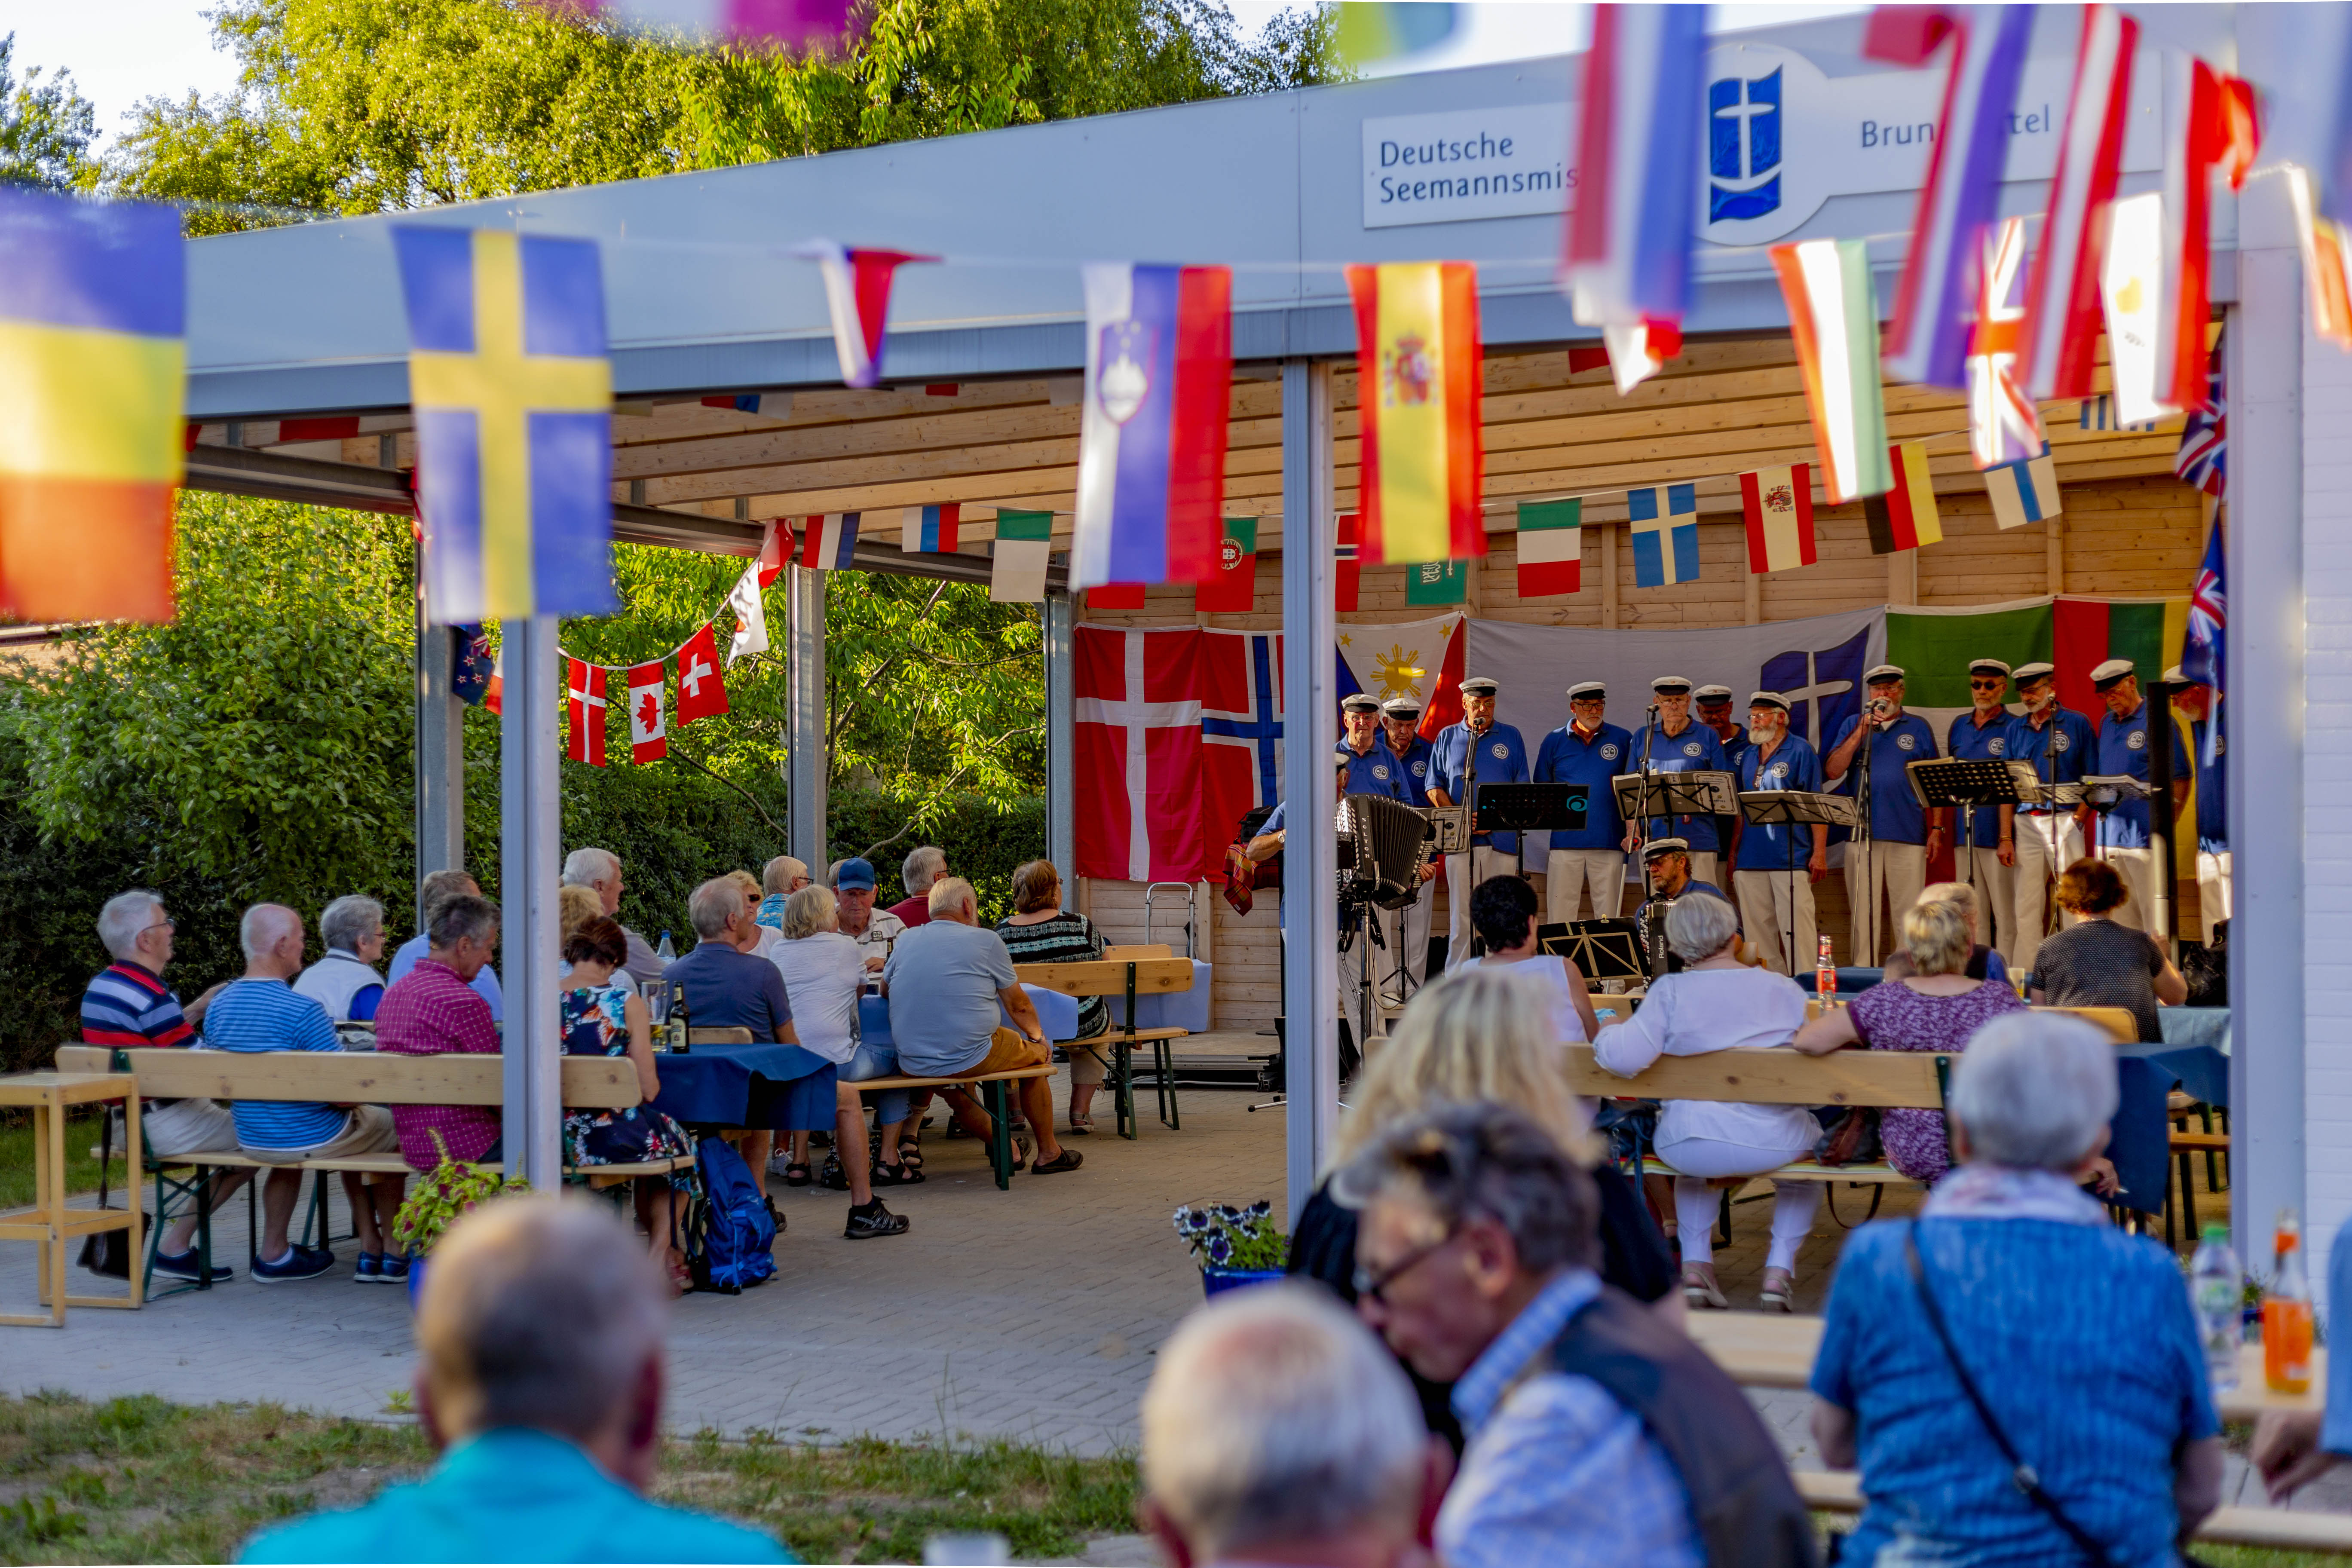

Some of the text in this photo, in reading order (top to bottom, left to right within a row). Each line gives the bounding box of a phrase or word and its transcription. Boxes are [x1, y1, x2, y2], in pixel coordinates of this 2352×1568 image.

[1862, 104, 2050, 147] Bruntel
[1381, 132, 1513, 167] Deutsche
[1381, 162, 1579, 203] Seemannsmis
[1362, 818, 1370, 858] SOLTON
